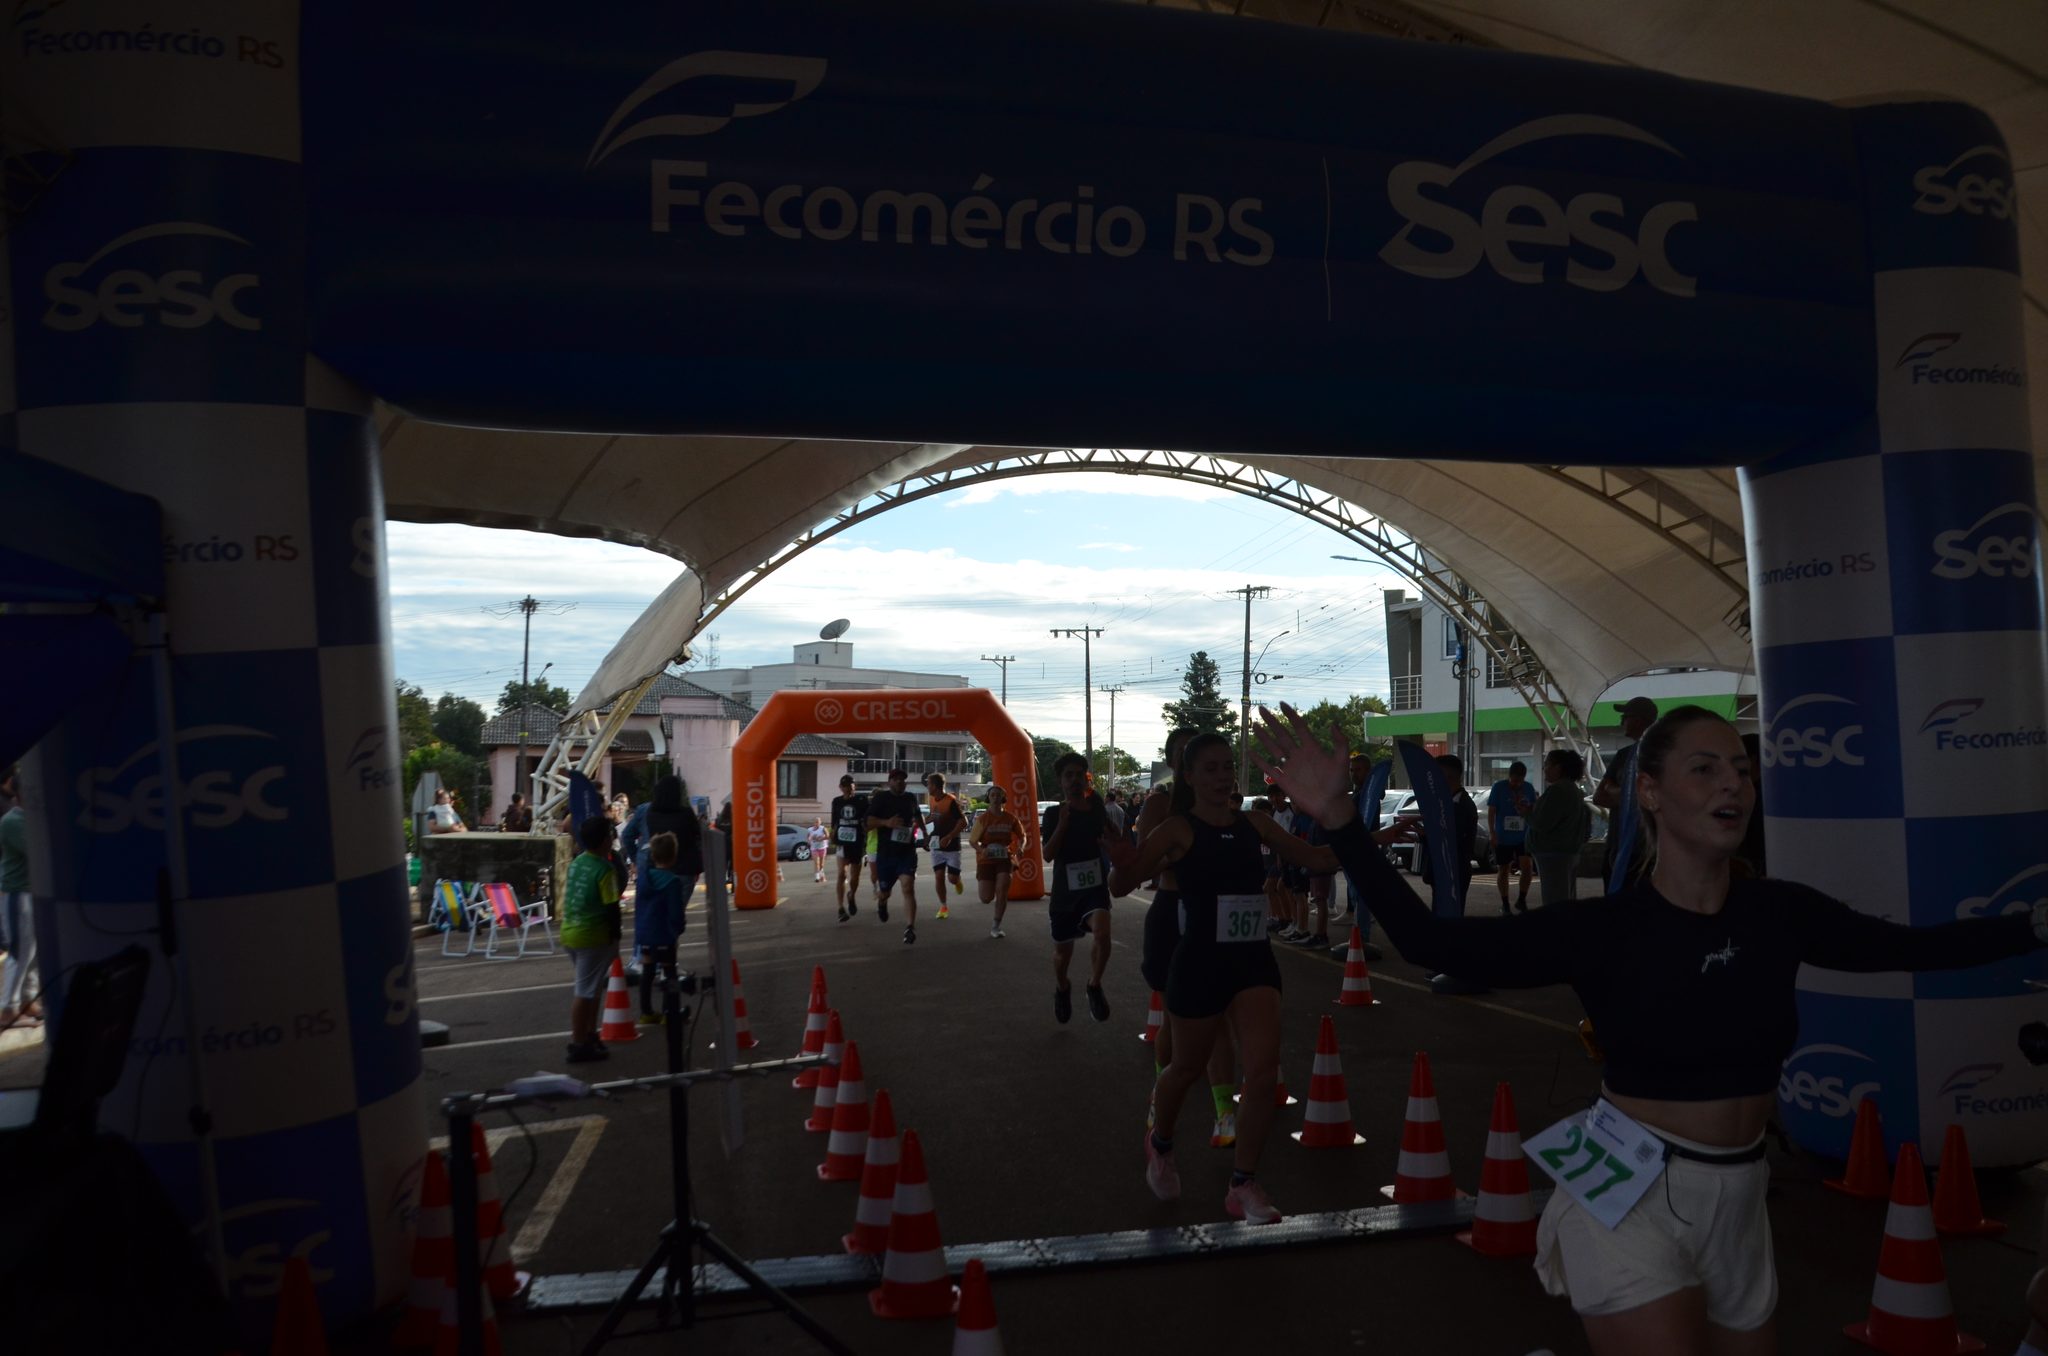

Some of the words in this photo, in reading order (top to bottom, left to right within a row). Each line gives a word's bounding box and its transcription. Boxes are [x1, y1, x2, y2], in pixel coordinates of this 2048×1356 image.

[23, 24, 225, 58] Fecomércio
[238, 35, 284, 69] RS
[650, 158, 1147, 258] Fecomércio
[1172, 192, 1275, 267] RS
[1378, 150, 1699, 299] Sesc
[42, 260, 263, 332] Sesc
[162, 536, 243, 563] ércio
[255, 534, 299, 562] RS
[1840, 552, 1876, 575] RS
[1930, 528, 2036, 580] Ses
[851, 699, 957, 721] CRESOL
[76, 764, 289, 834] Sesc
[747, 774, 765, 863] CRESOL
[1077, 870, 1095, 888] 96
[1228, 910, 1262, 938] 367
[1539, 1124, 1635, 1202] 277
